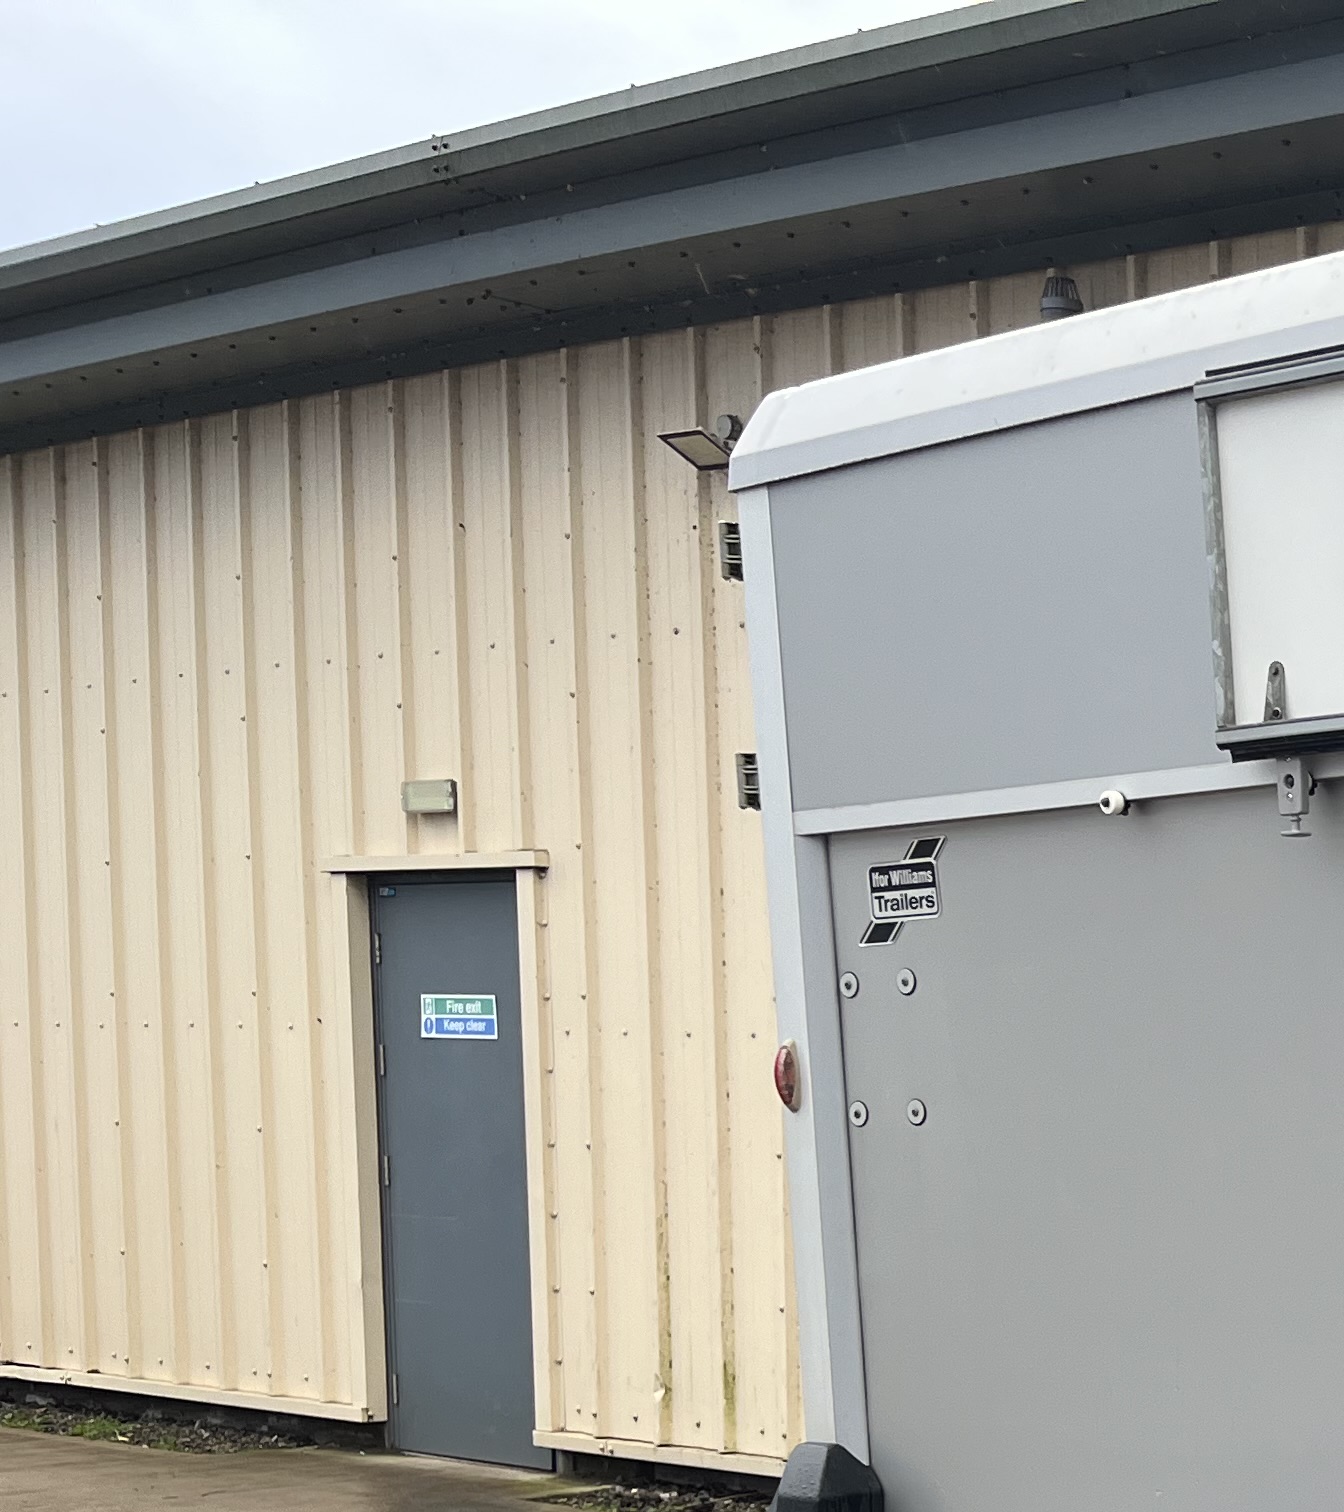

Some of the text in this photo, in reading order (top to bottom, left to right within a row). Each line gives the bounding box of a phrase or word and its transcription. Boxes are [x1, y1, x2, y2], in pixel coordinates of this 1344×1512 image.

[872, 869, 932, 887] Ifor Williams
[874, 893, 935, 912] Trailers
[446, 1000, 481, 1013] Fire exit
[443, 1019, 486, 1034] Keep clear
